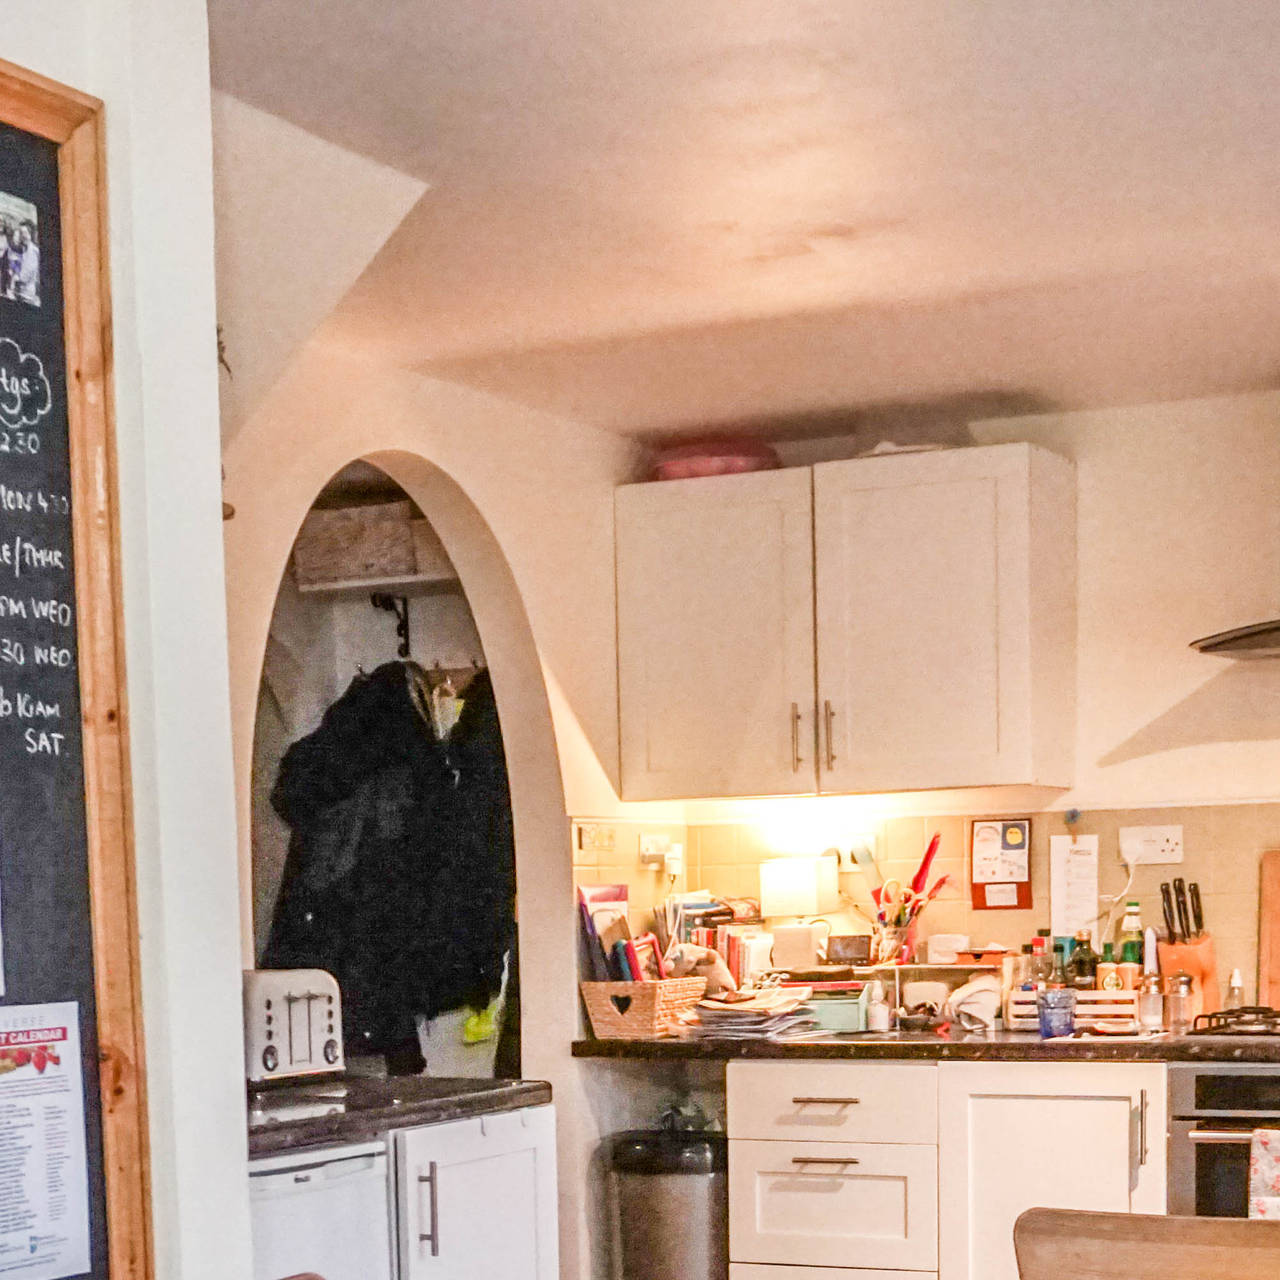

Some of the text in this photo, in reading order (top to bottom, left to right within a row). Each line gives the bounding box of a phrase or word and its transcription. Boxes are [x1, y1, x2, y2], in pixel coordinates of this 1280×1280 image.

[31, 597, 72, 627] WED
[34, 647, 72, 667] WED
[8, 1028, 63, 1044] CALENDAR
